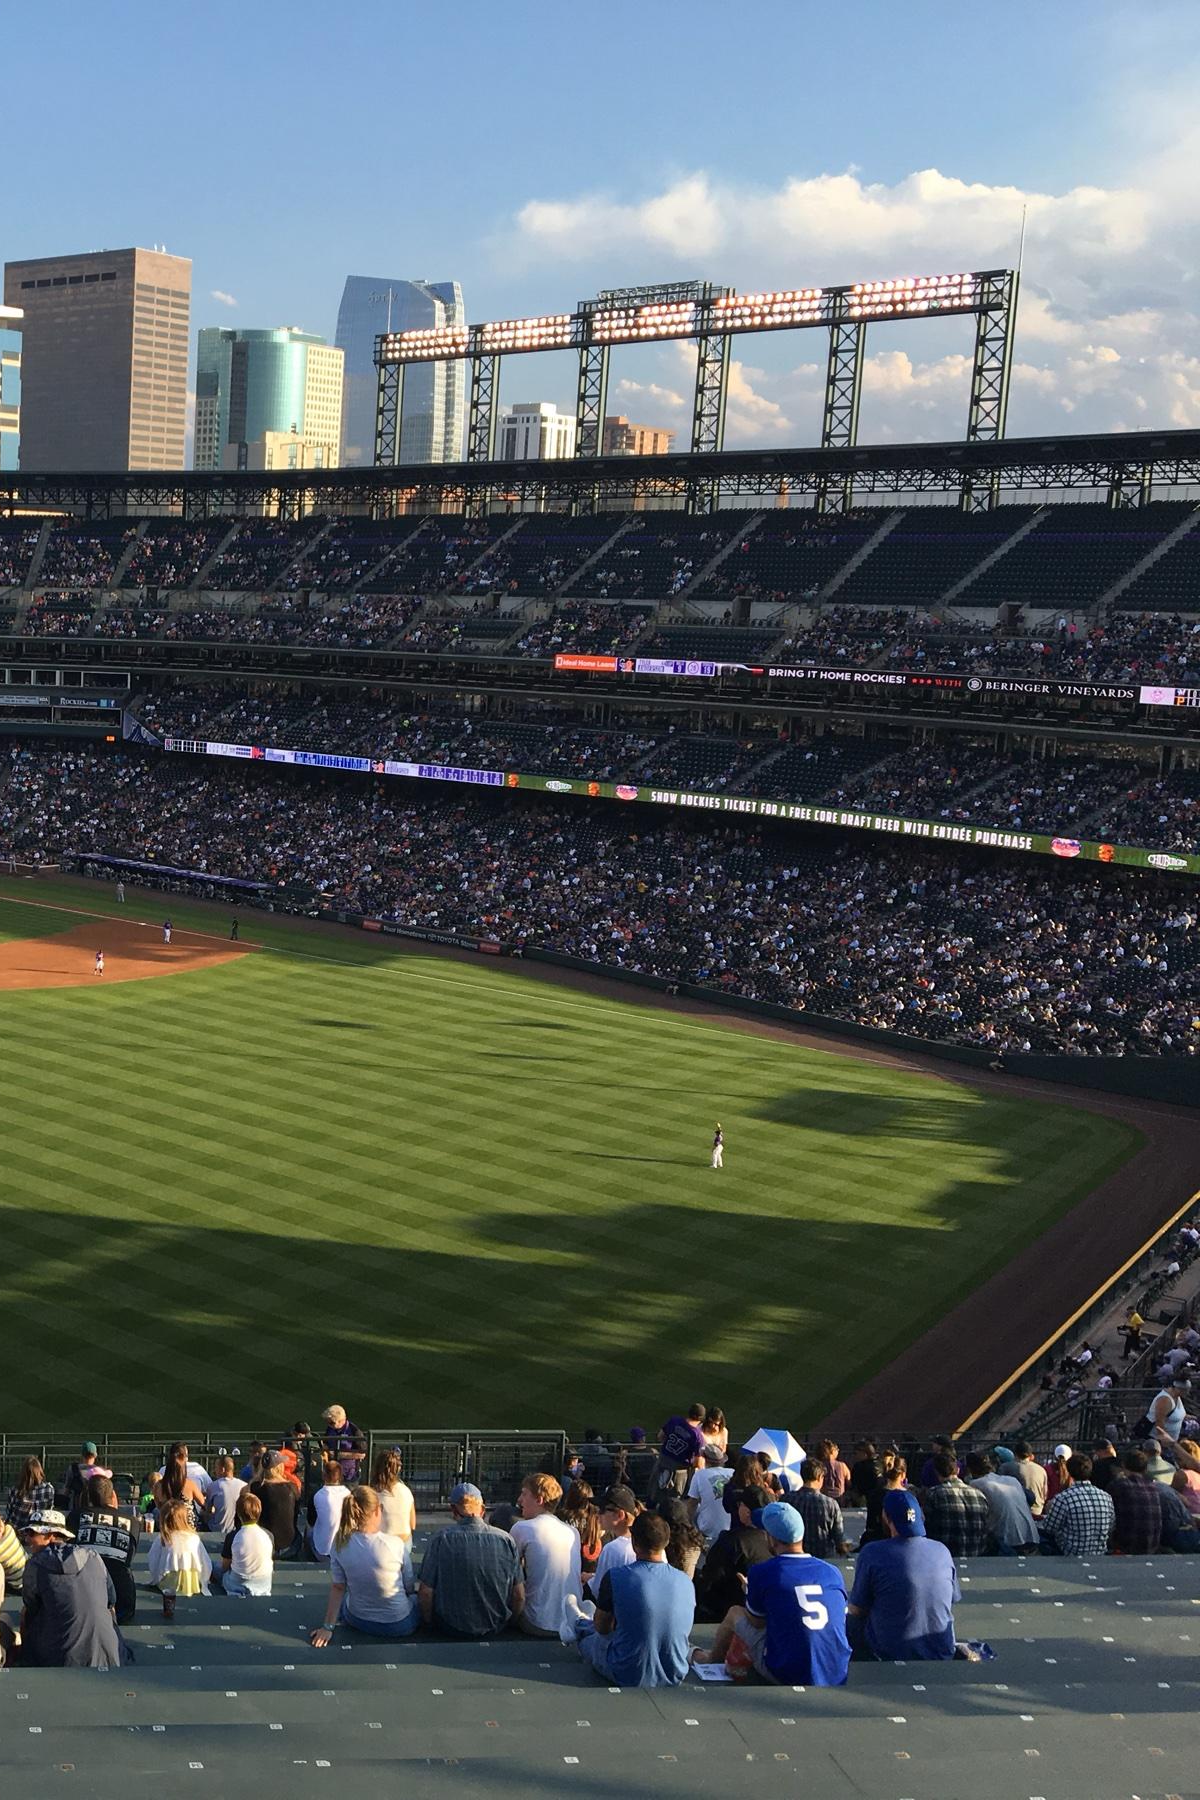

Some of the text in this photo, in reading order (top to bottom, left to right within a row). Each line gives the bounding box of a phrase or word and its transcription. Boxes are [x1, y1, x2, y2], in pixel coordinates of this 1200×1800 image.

[769, 668, 906, 684] BRING IT HOME ROCKIES!
[935, 679, 962, 688] WITH
[985, 681, 1135, 699] BERINGER VINEYARDS
[651, 791, 677, 803] SHOW
[680, 794, 721, 809] ROCKIES
[724, 798, 757, 813] TICKET
[760, 802, 778, 815] FOR
[780, 805, 786, 817] A
[789, 806, 811, 820] FREE
[815, 809, 838, 824] CORE
[841, 813, 871, 828] DRAFT
[875, 817, 900, 832] BEER
[903, 821, 929, 836] WITH
[933, 825, 971, 842] ENTRÉE
[975, 831, 1032, 850] PURCHASE
[437, 936, 459, 945] TOYOTA
[666, 1433, 688, 1455] 27
[794, 1584, 828, 1630] 5
